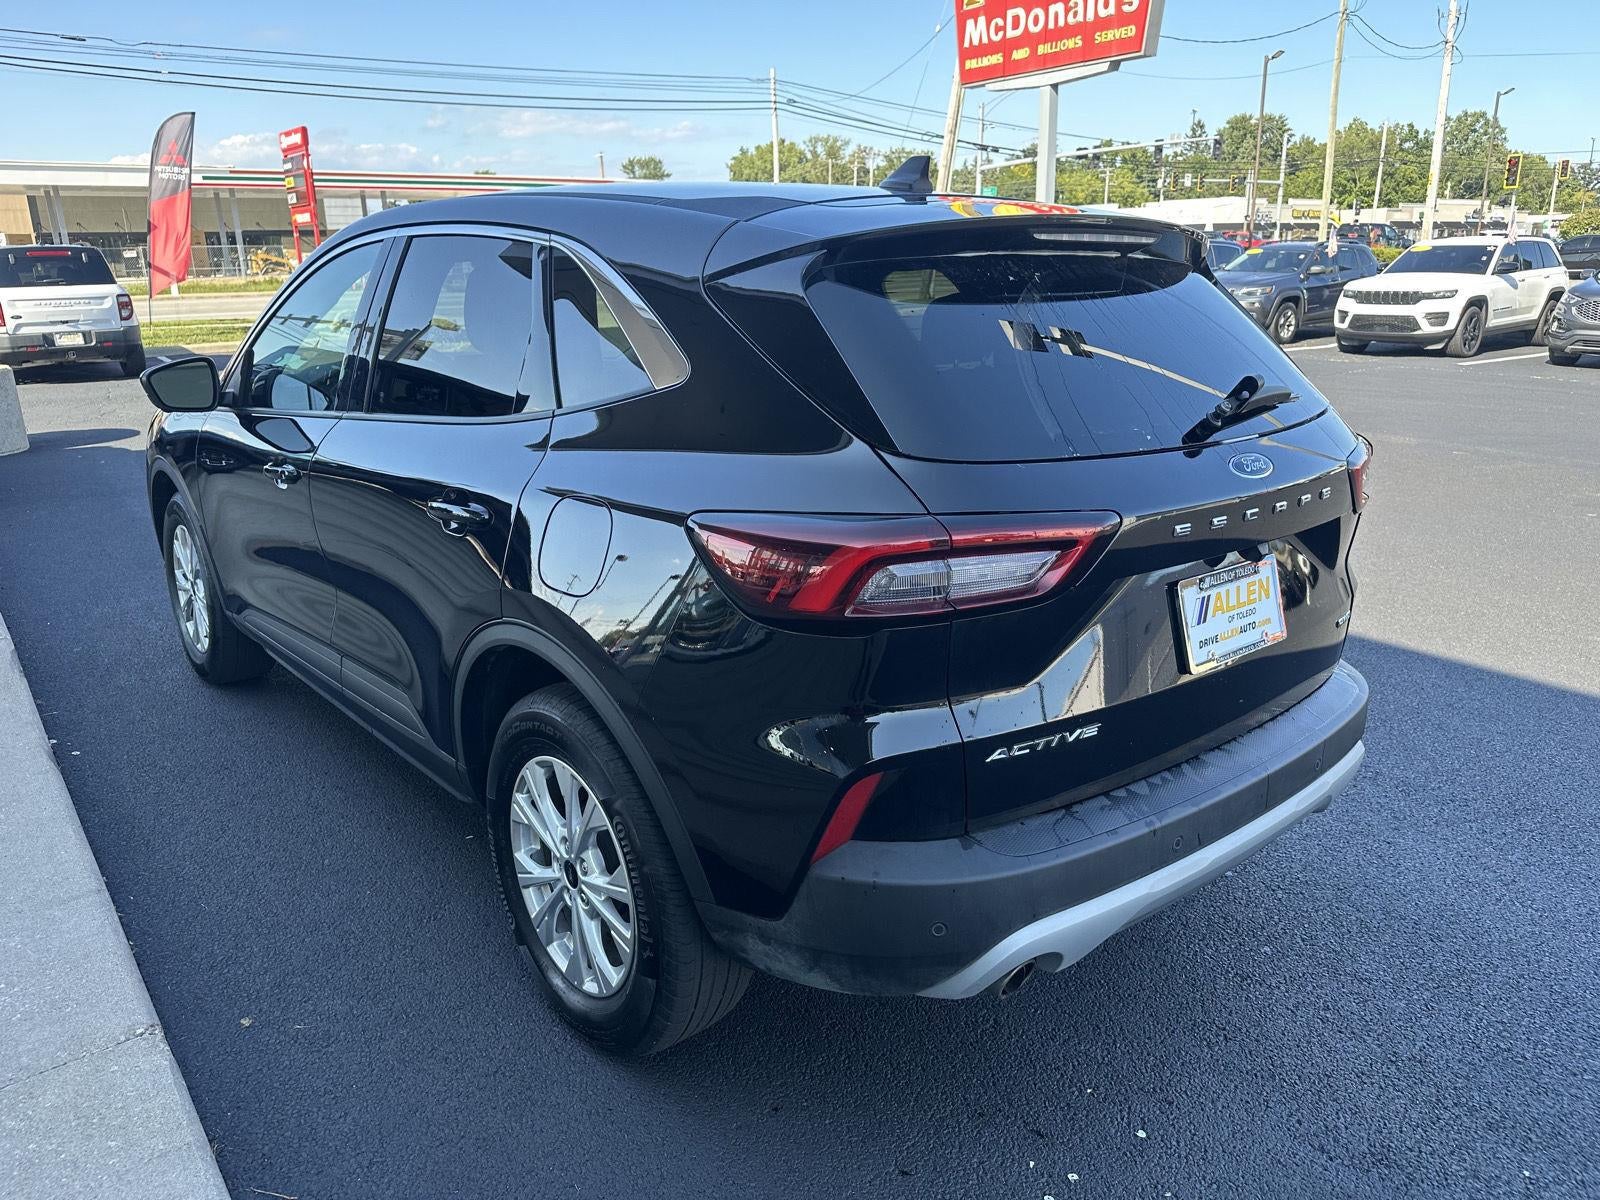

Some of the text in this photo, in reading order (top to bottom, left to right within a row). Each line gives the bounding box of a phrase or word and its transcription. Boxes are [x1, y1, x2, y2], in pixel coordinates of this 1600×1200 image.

[965, 24, 1137, 71] BILLIONS AND BILLIONS SERVED
[158, 172, 186, 181] MOTORS
[1241, 456, 1267, 472] Ford
[1173, 487, 1332, 537] ESCAPE
[1210, 571, 1228, 586] ALLEN
[1228, 569, 1236, 580] OF
[1236, 565, 1255, 577] TOLEDO
[1212, 576, 1271, 618] ALLEN
[1228, 607, 1257, 624] OF TOLEDO
[985, 723, 1102, 763] ACTIVE
